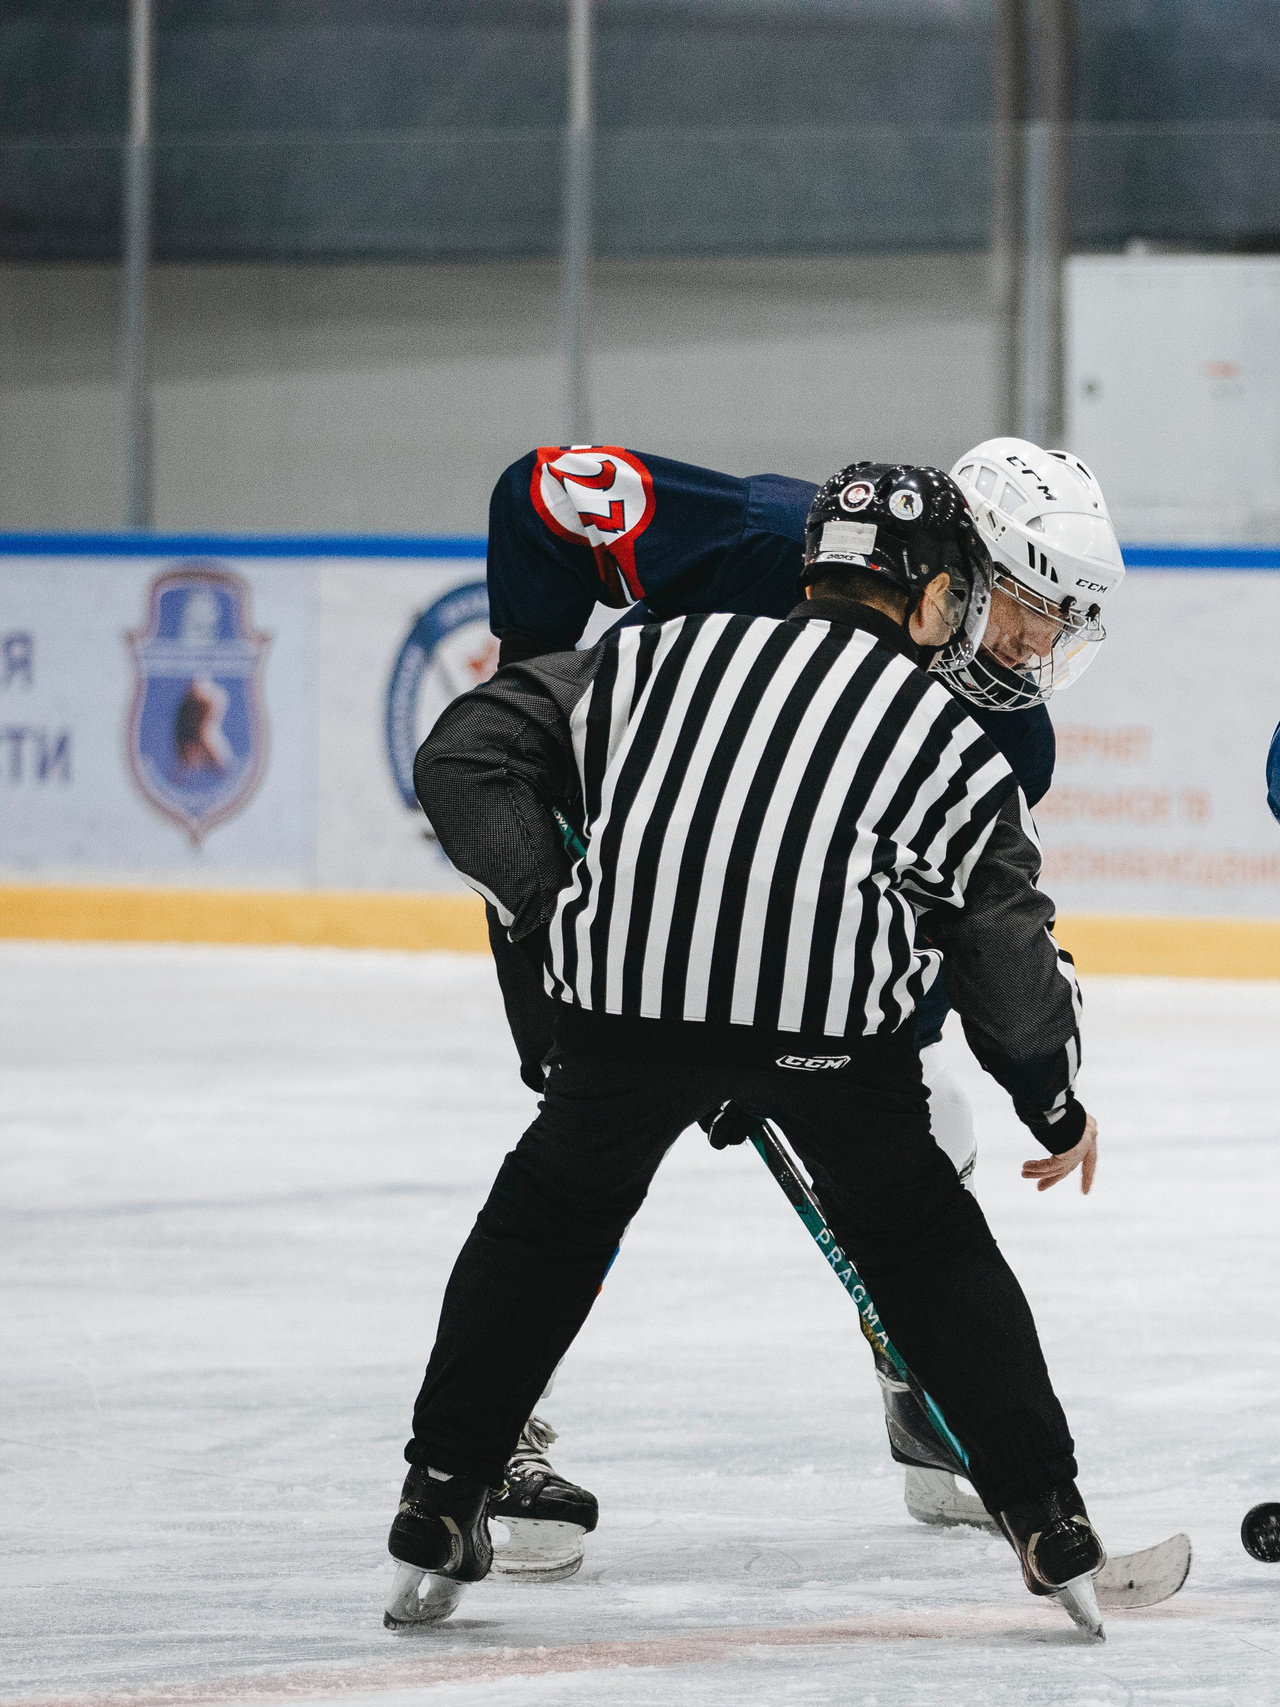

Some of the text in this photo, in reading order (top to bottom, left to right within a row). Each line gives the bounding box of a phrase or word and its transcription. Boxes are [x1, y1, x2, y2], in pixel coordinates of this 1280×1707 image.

[1075, 578, 1109, 594] CCM
[552, 806, 568, 831] OVA
[784, 1055, 847, 1070] CCM
[815, 1228, 890, 1348] PRAGMA
